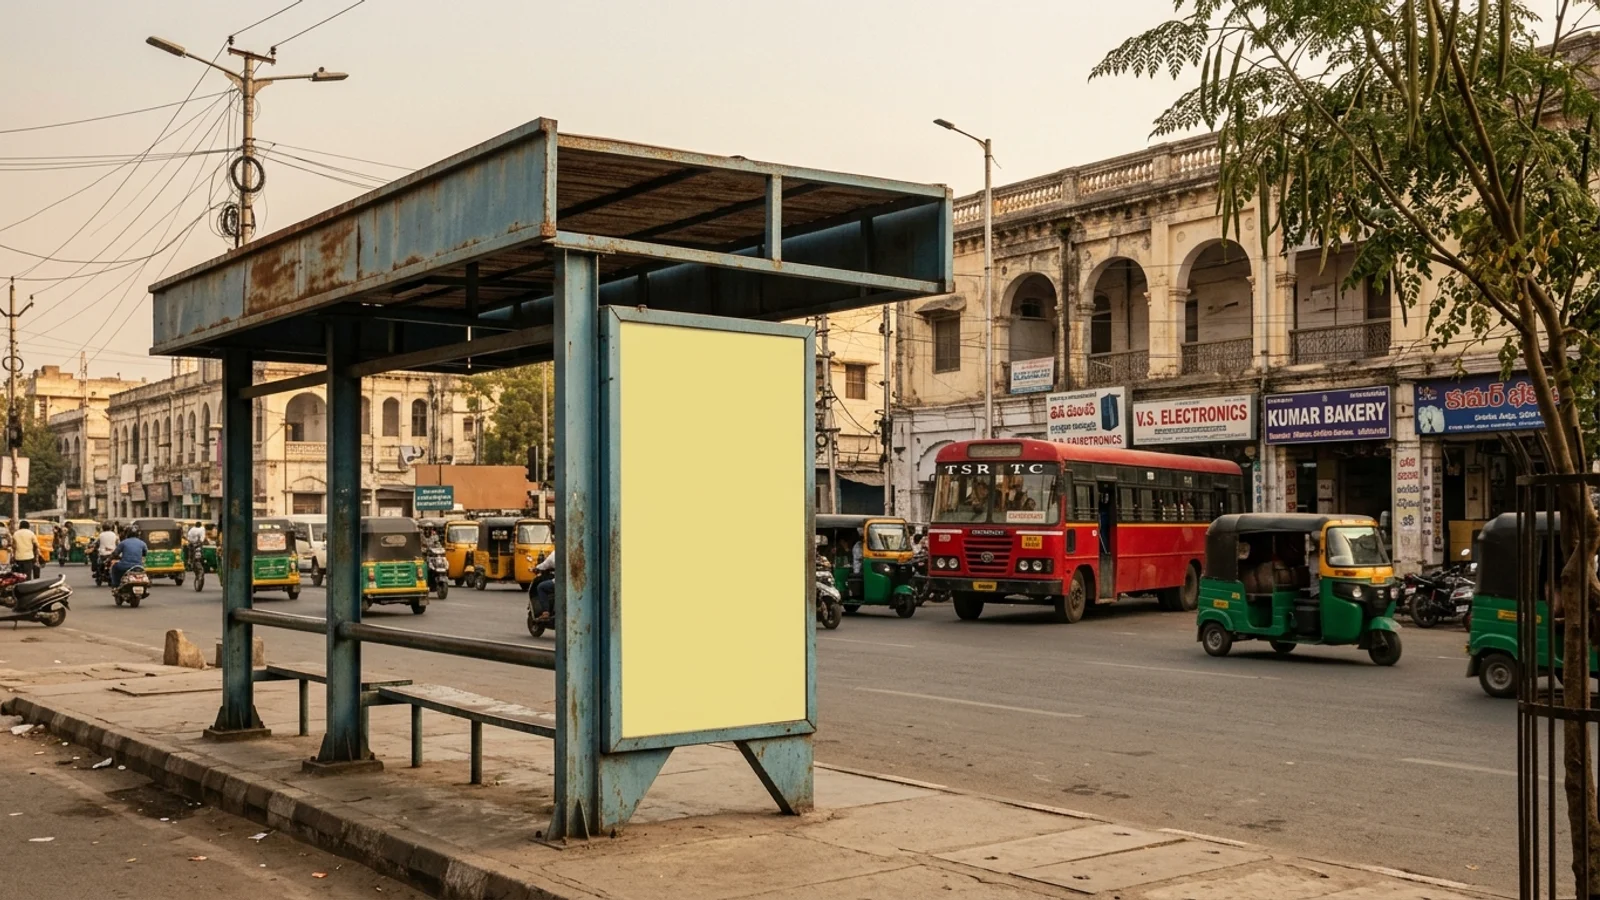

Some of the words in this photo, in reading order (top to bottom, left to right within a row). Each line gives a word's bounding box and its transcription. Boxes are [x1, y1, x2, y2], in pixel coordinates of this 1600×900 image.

[1136, 410, 1157, 427] V.S.
[1161, 404, 1247, 425] ELECTRONICS
[1268, 406, 1321, 427] KUMAR
[1324, 402, 1386, 424] BAKERY
